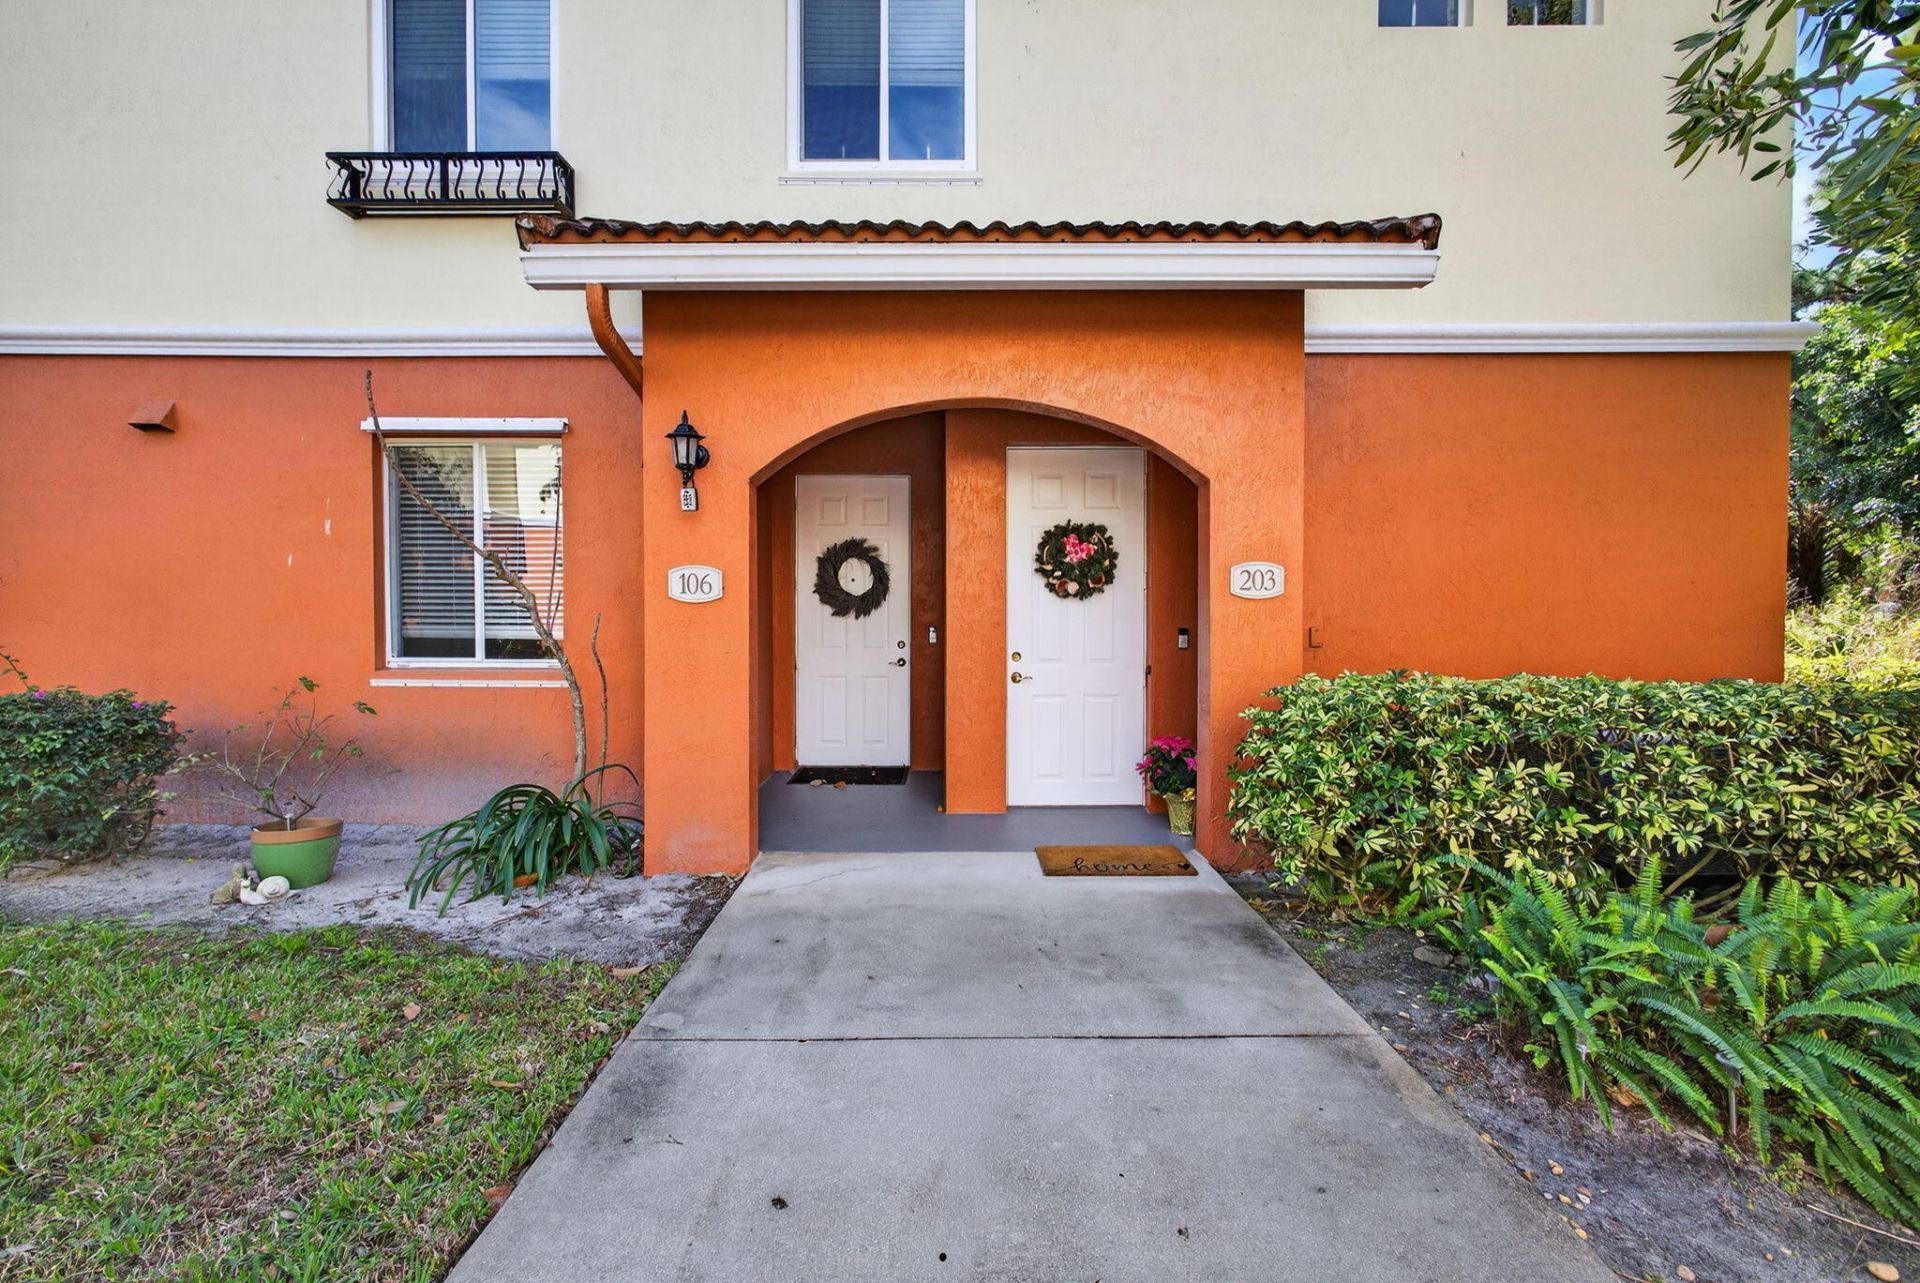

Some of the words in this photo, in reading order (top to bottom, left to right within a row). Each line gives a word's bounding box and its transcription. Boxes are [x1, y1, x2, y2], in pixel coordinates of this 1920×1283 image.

[679, 573, 713, 595] 106
[1239, 569, 1276, 592] 203
[1073, 857, 1157, 872] home
